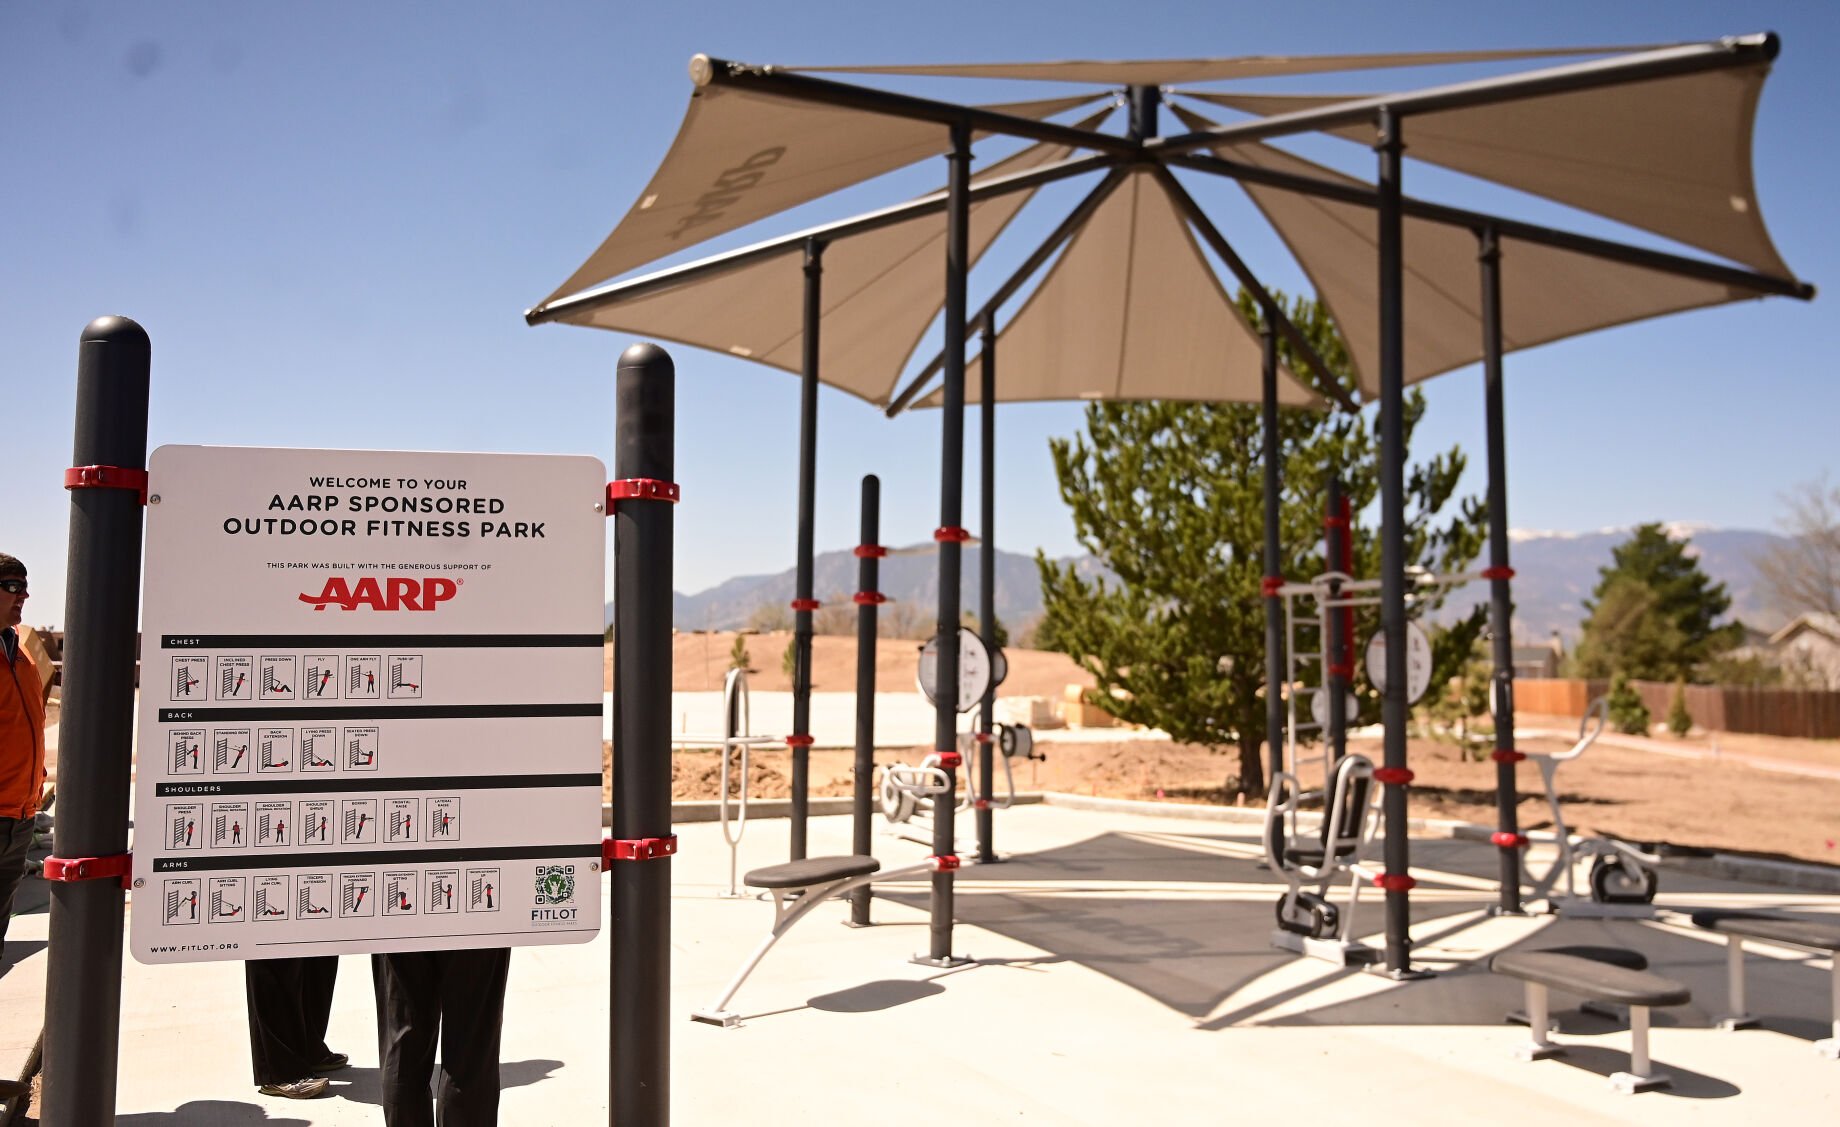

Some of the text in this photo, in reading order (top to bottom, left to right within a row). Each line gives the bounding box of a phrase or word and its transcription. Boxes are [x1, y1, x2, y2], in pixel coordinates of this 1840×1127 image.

[309, 477, 467, 490] WELCOME TO YOUR
[268, 494, 505, 514] AARP SPONSORED
[223, 518, 546, 538] OUTDOOR FITNESS PARK
[298, 577, 457, 611] AARP
[531, 909, 578, 920] FITLOT
[150, 943, 239, 952] WWW.FITLOT.ORG
